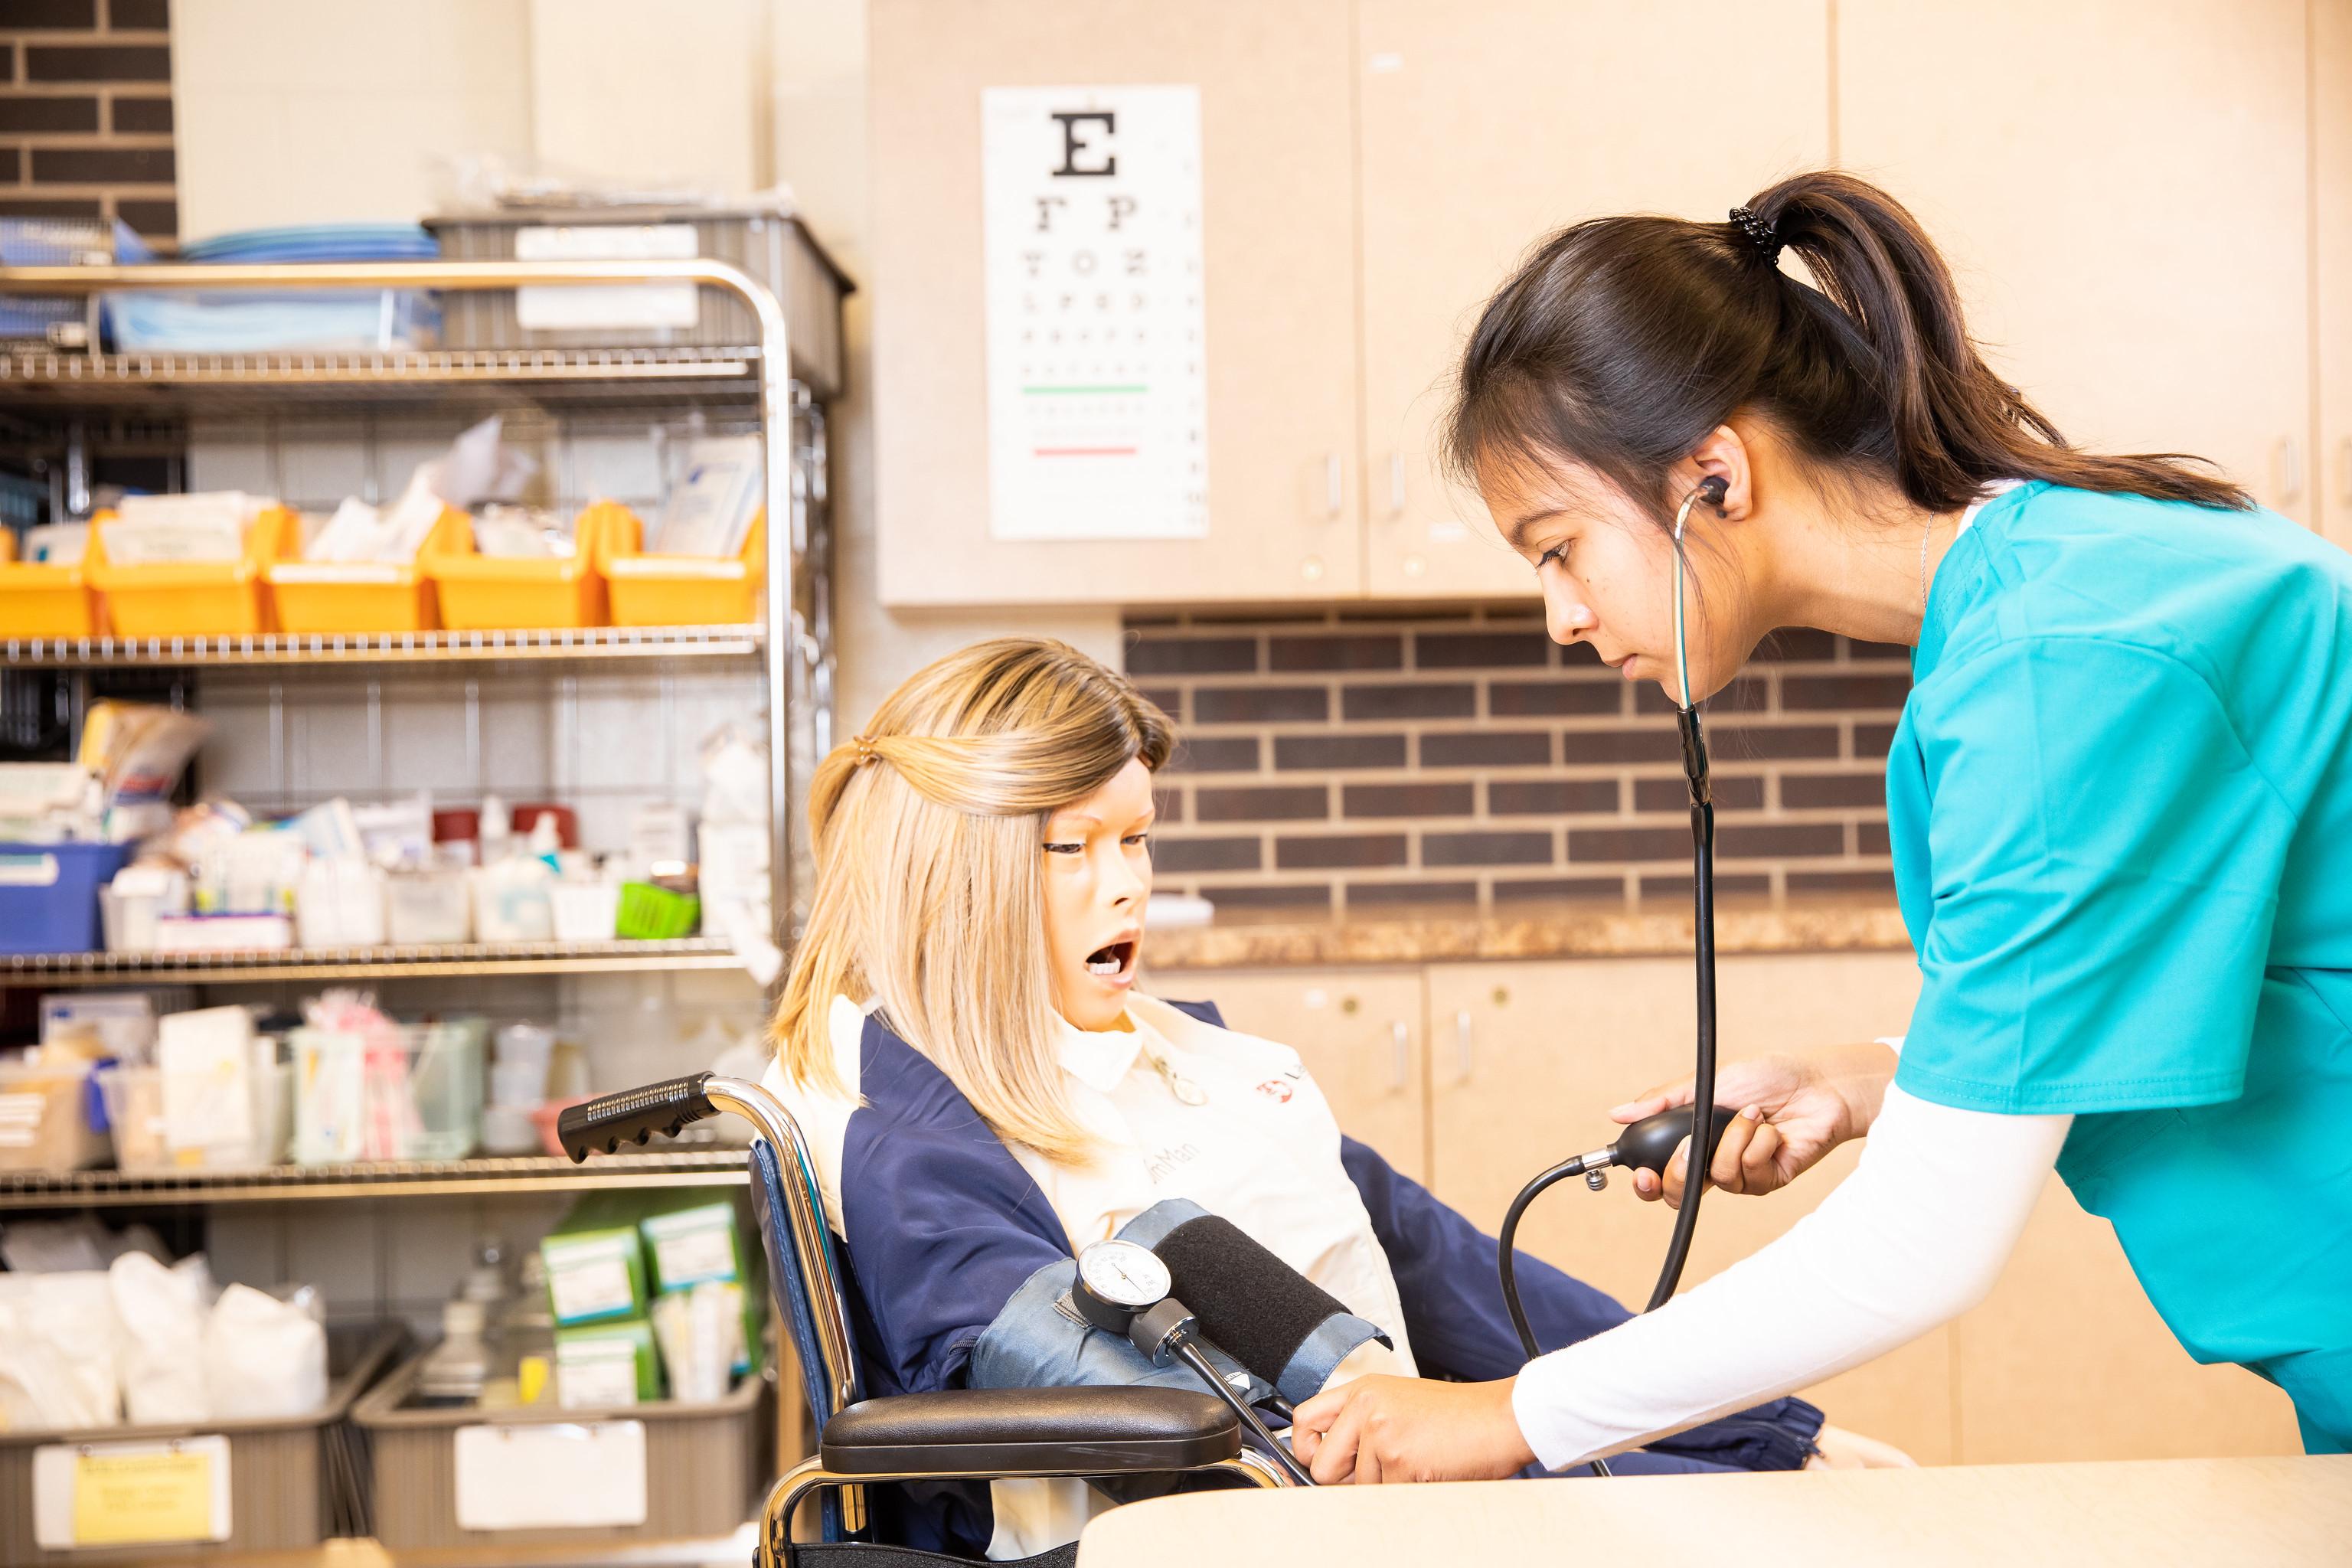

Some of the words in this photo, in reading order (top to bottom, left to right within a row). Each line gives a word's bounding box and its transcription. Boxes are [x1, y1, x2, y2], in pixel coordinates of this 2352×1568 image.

[1051, 113, 1115, 176] E
[1108, 196, 1138, 230] P
[1070, 248, 1099, 278] O
